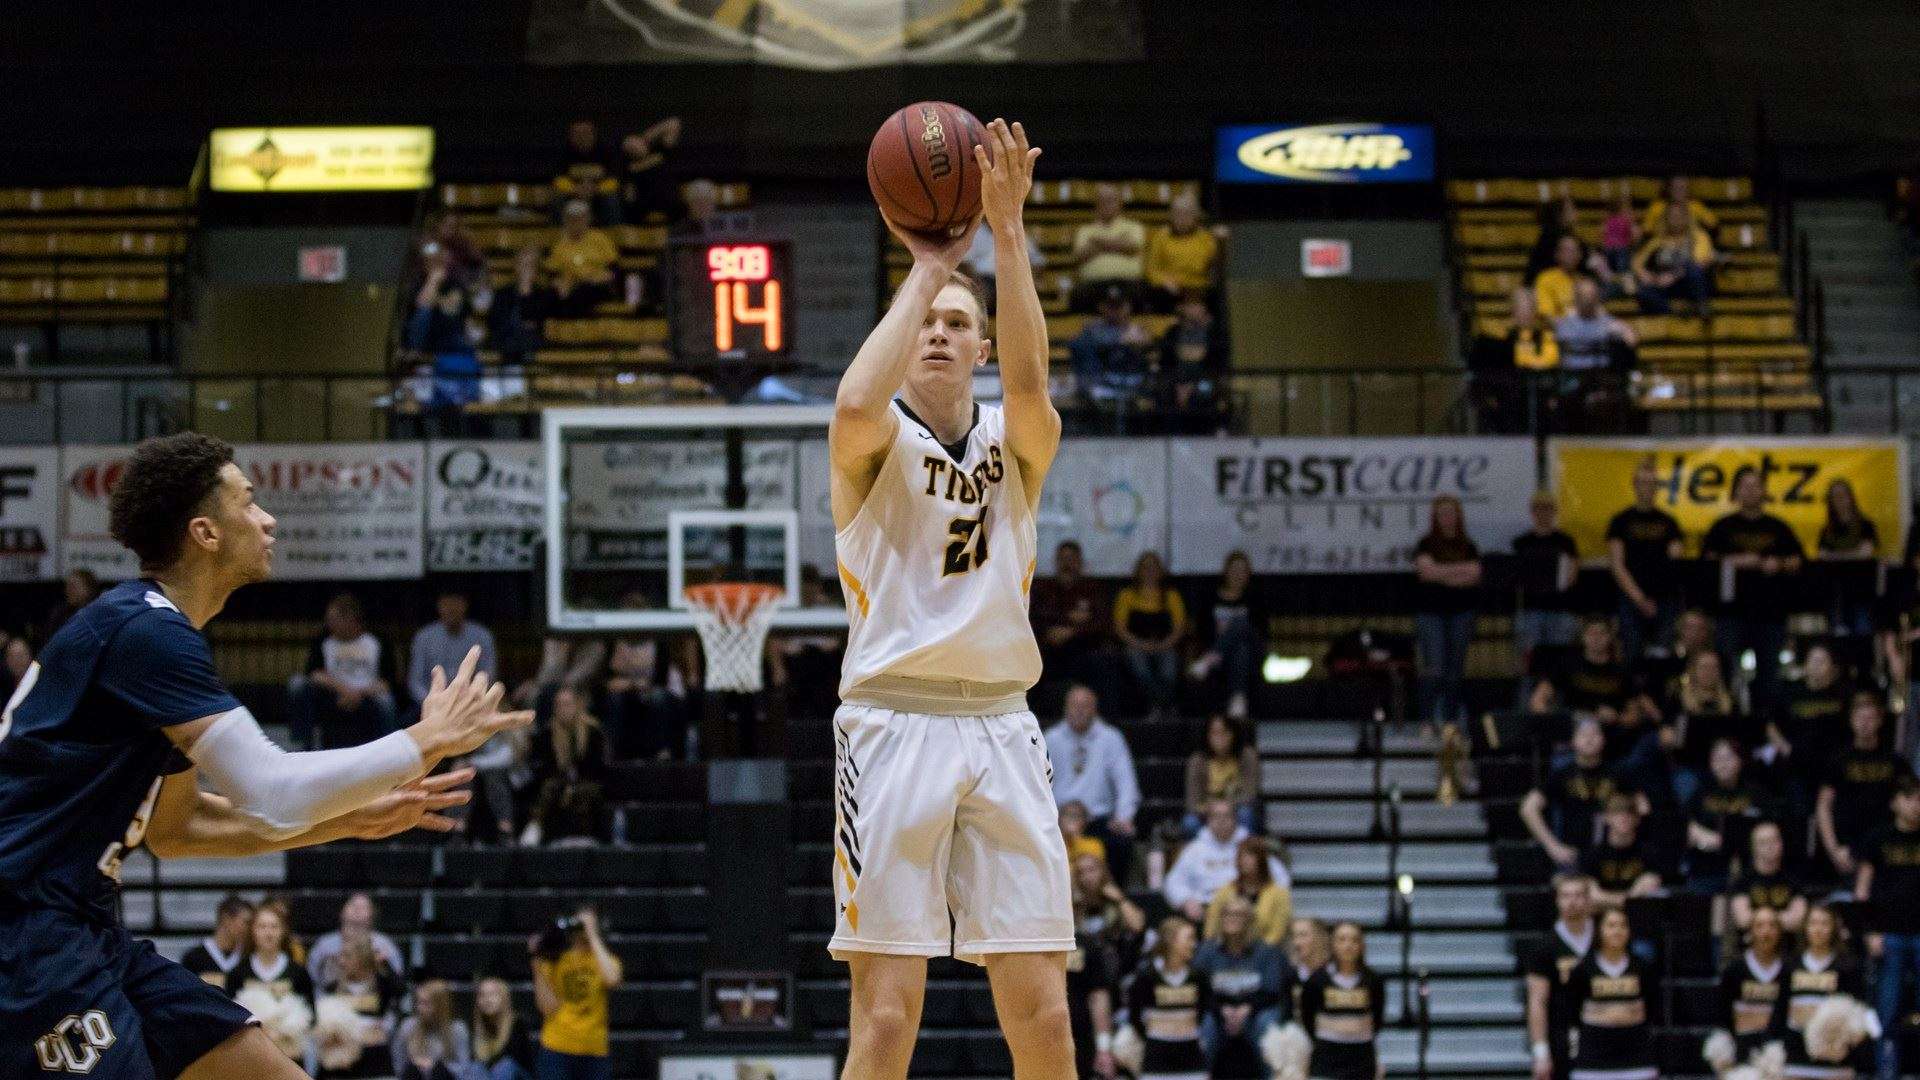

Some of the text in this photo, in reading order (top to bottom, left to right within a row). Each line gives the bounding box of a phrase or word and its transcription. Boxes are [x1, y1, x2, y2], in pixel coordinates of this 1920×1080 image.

[715, 280, 781, 351] 14
[1236, 502, 1418, 531] CLINI
[34, 1009, 117, 1074] UCO
